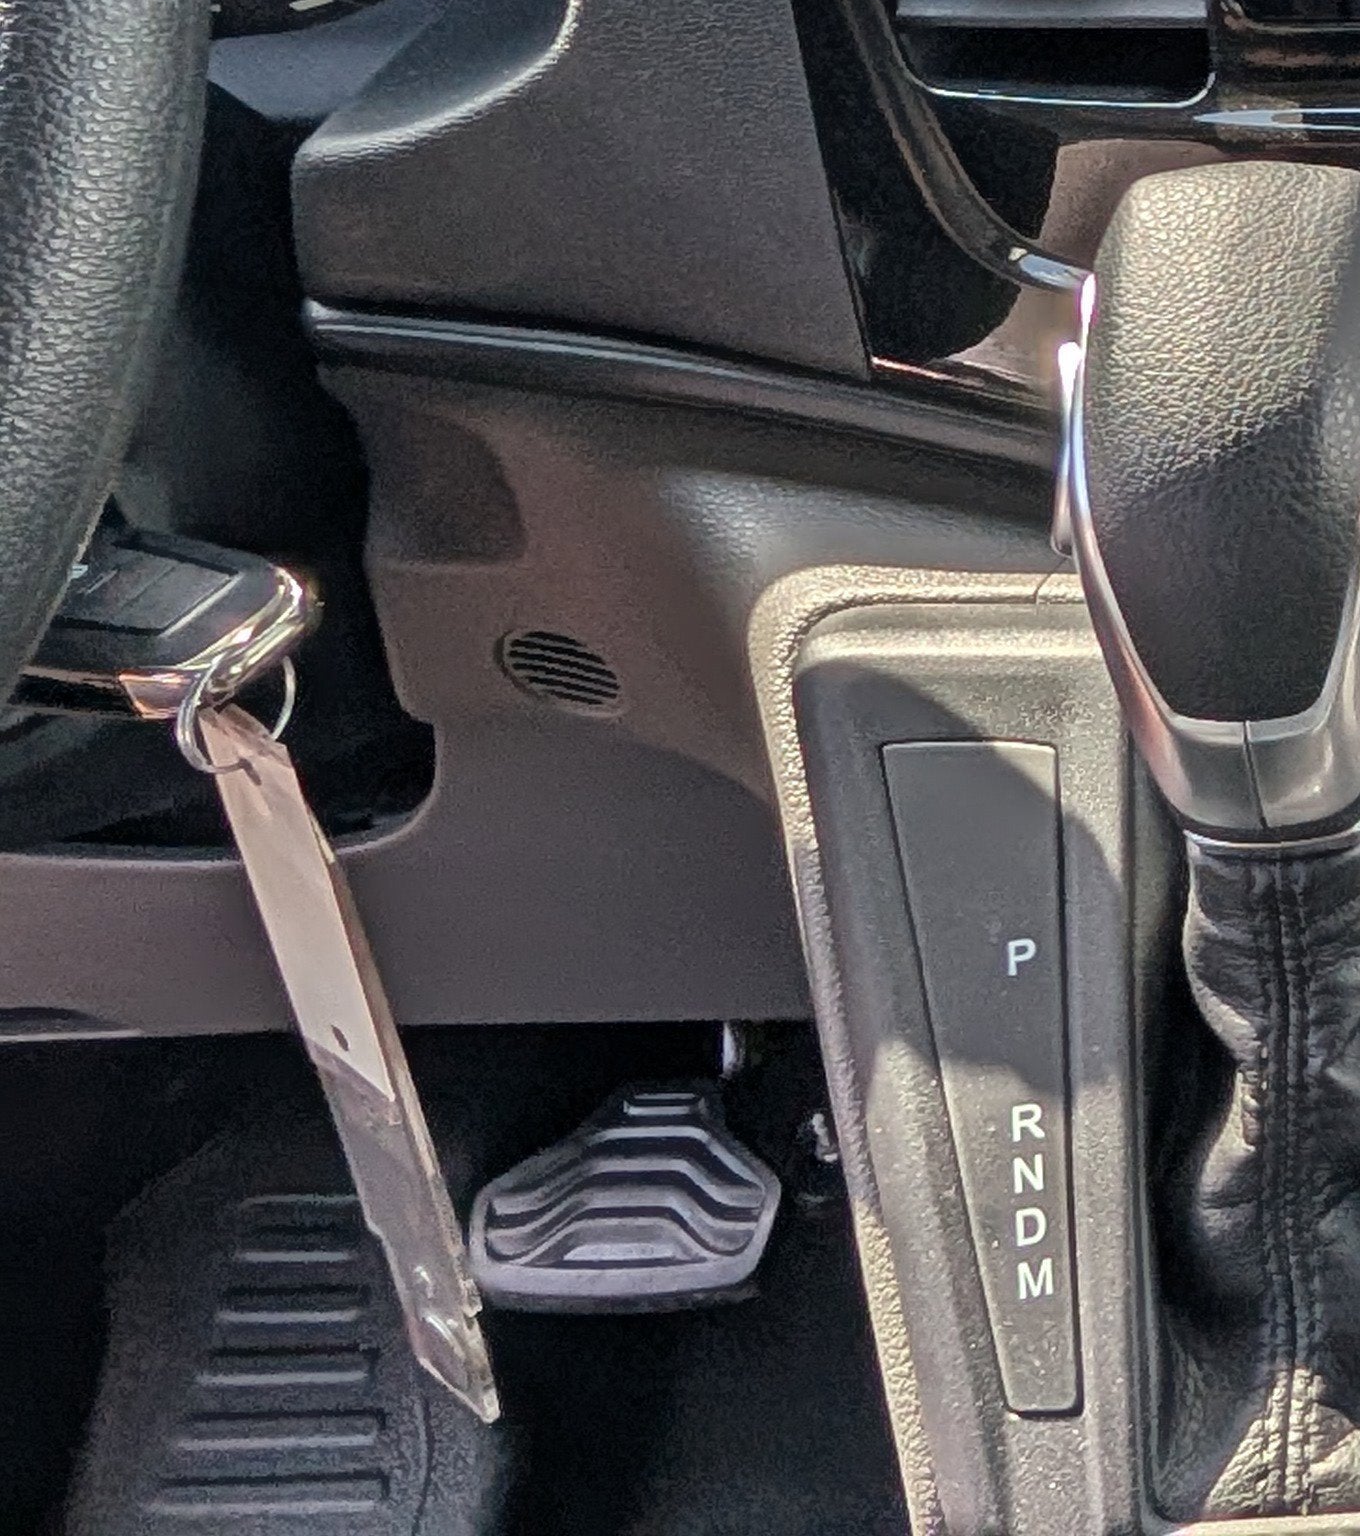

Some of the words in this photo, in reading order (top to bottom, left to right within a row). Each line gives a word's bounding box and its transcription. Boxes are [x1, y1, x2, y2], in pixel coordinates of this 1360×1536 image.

[1007, 938, 1037, 977] P
[1011, 1102, 1046, 1143] R
[1013, 1153, 1045, 1194] N
[1015, 1206, 1048, 1247] D
[1017, 1257, 1055, 1301] M
